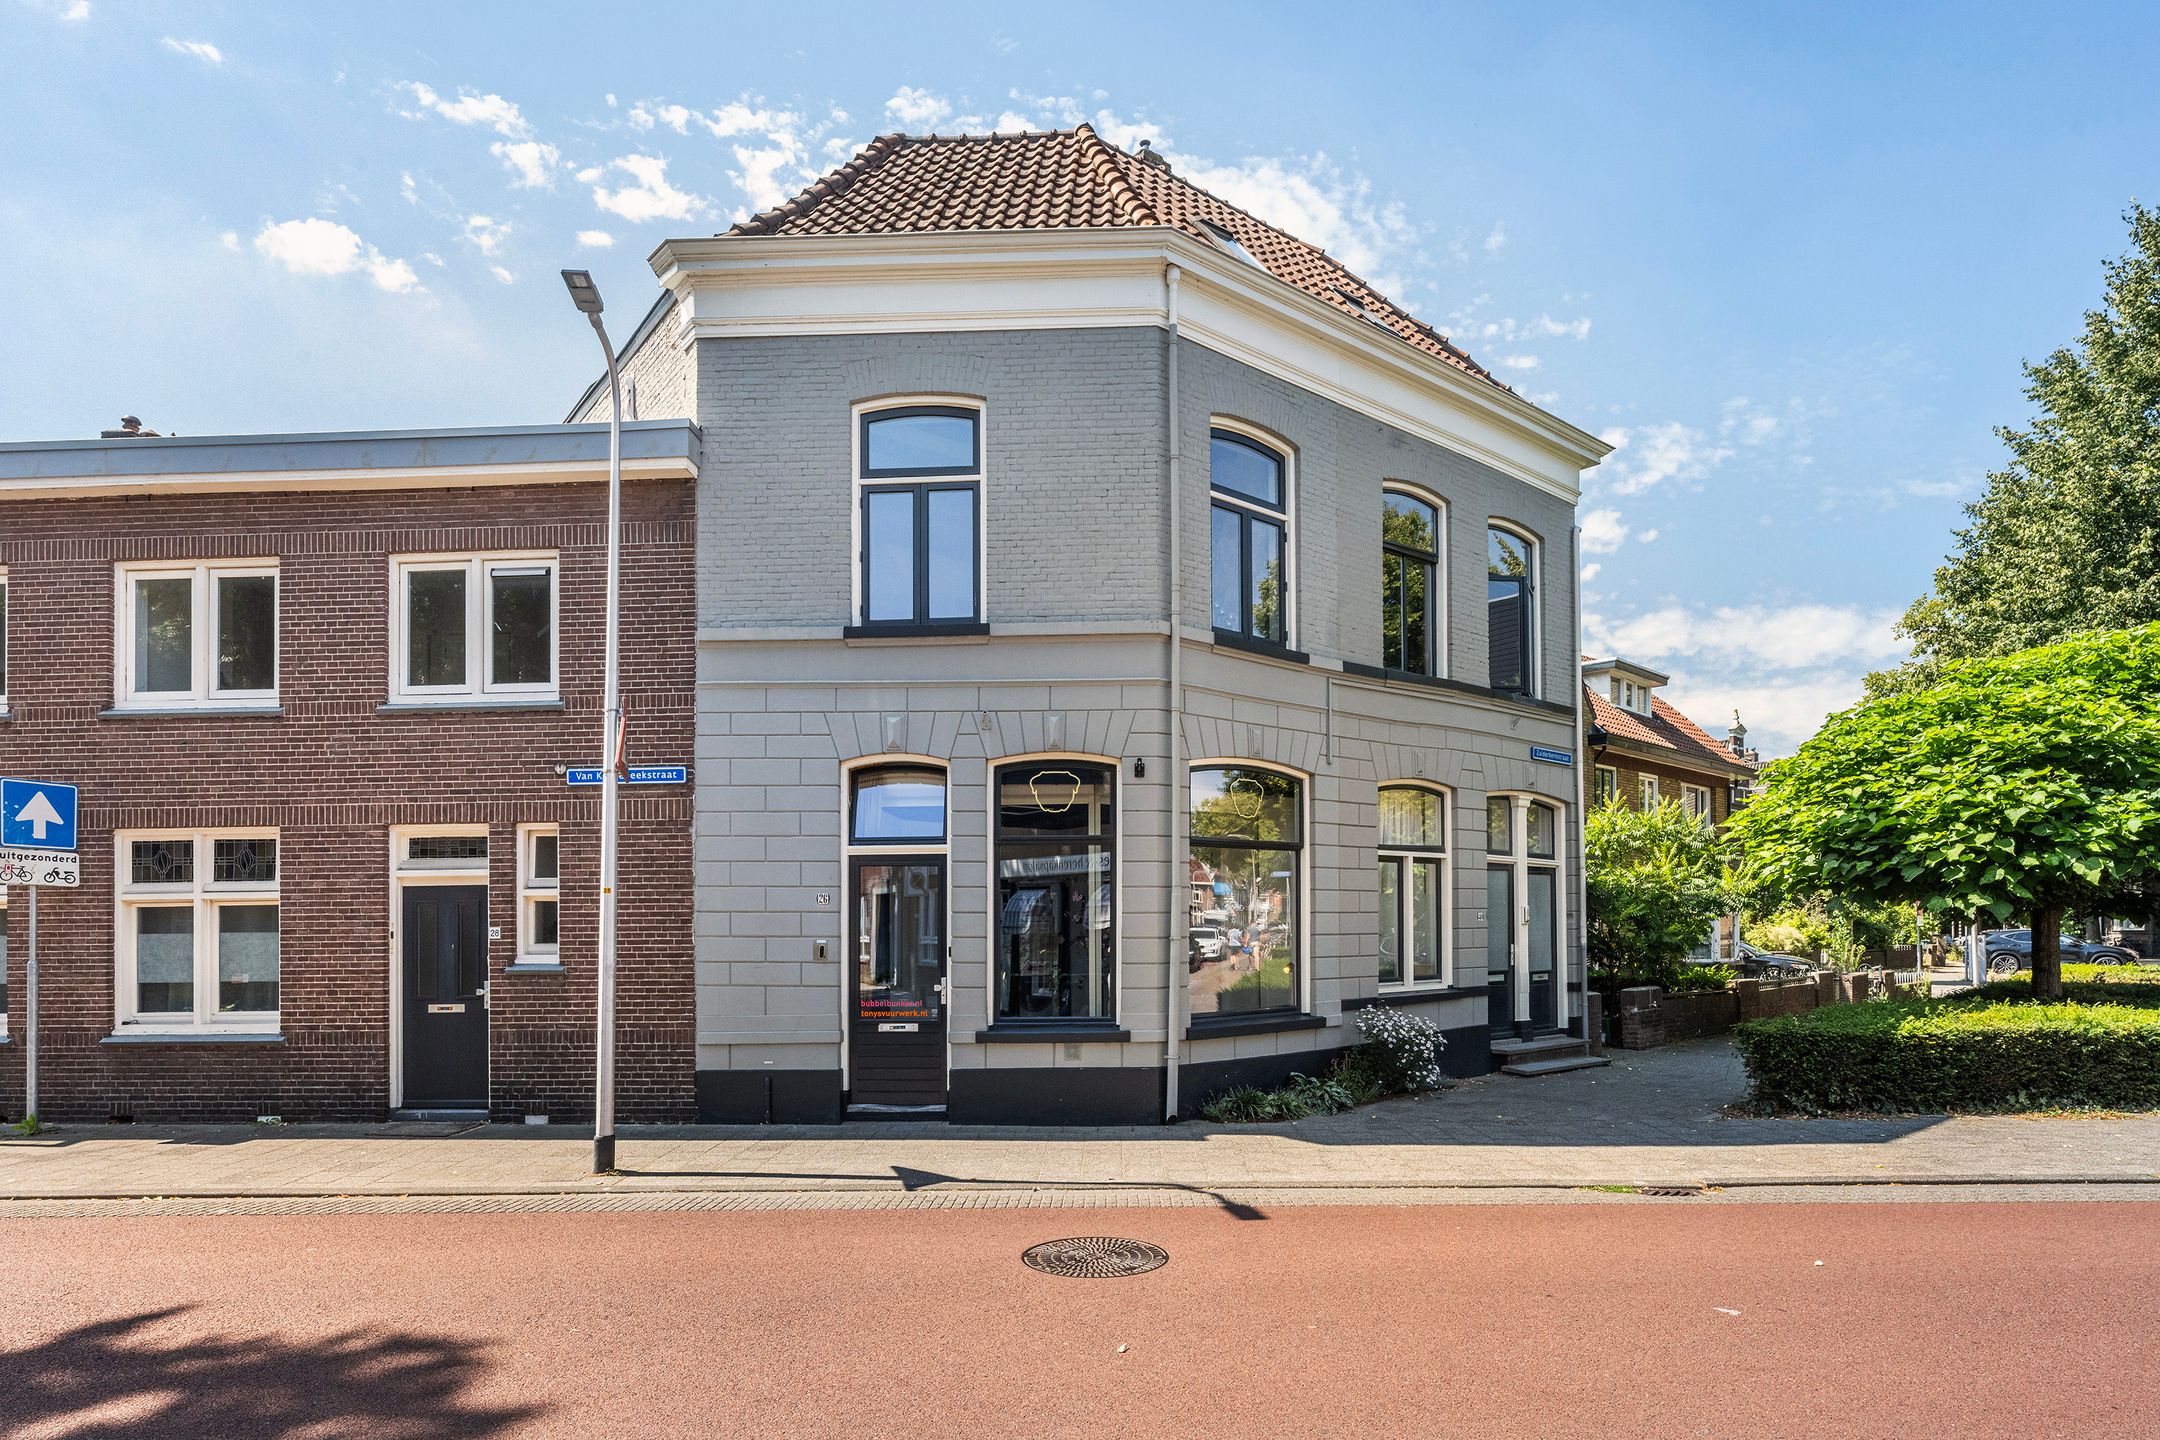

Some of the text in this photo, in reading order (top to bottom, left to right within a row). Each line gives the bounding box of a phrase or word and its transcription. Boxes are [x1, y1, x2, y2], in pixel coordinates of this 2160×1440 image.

[576, 770, 678, 780] Van Keeekstraat
[0, 852, 77, 863] uitgezonderd
[819, 894, 828, 904] 26
[490, 929, 499, 937] 28
[860, 1009, 929, 1018] tonysvuurwerk.nl
